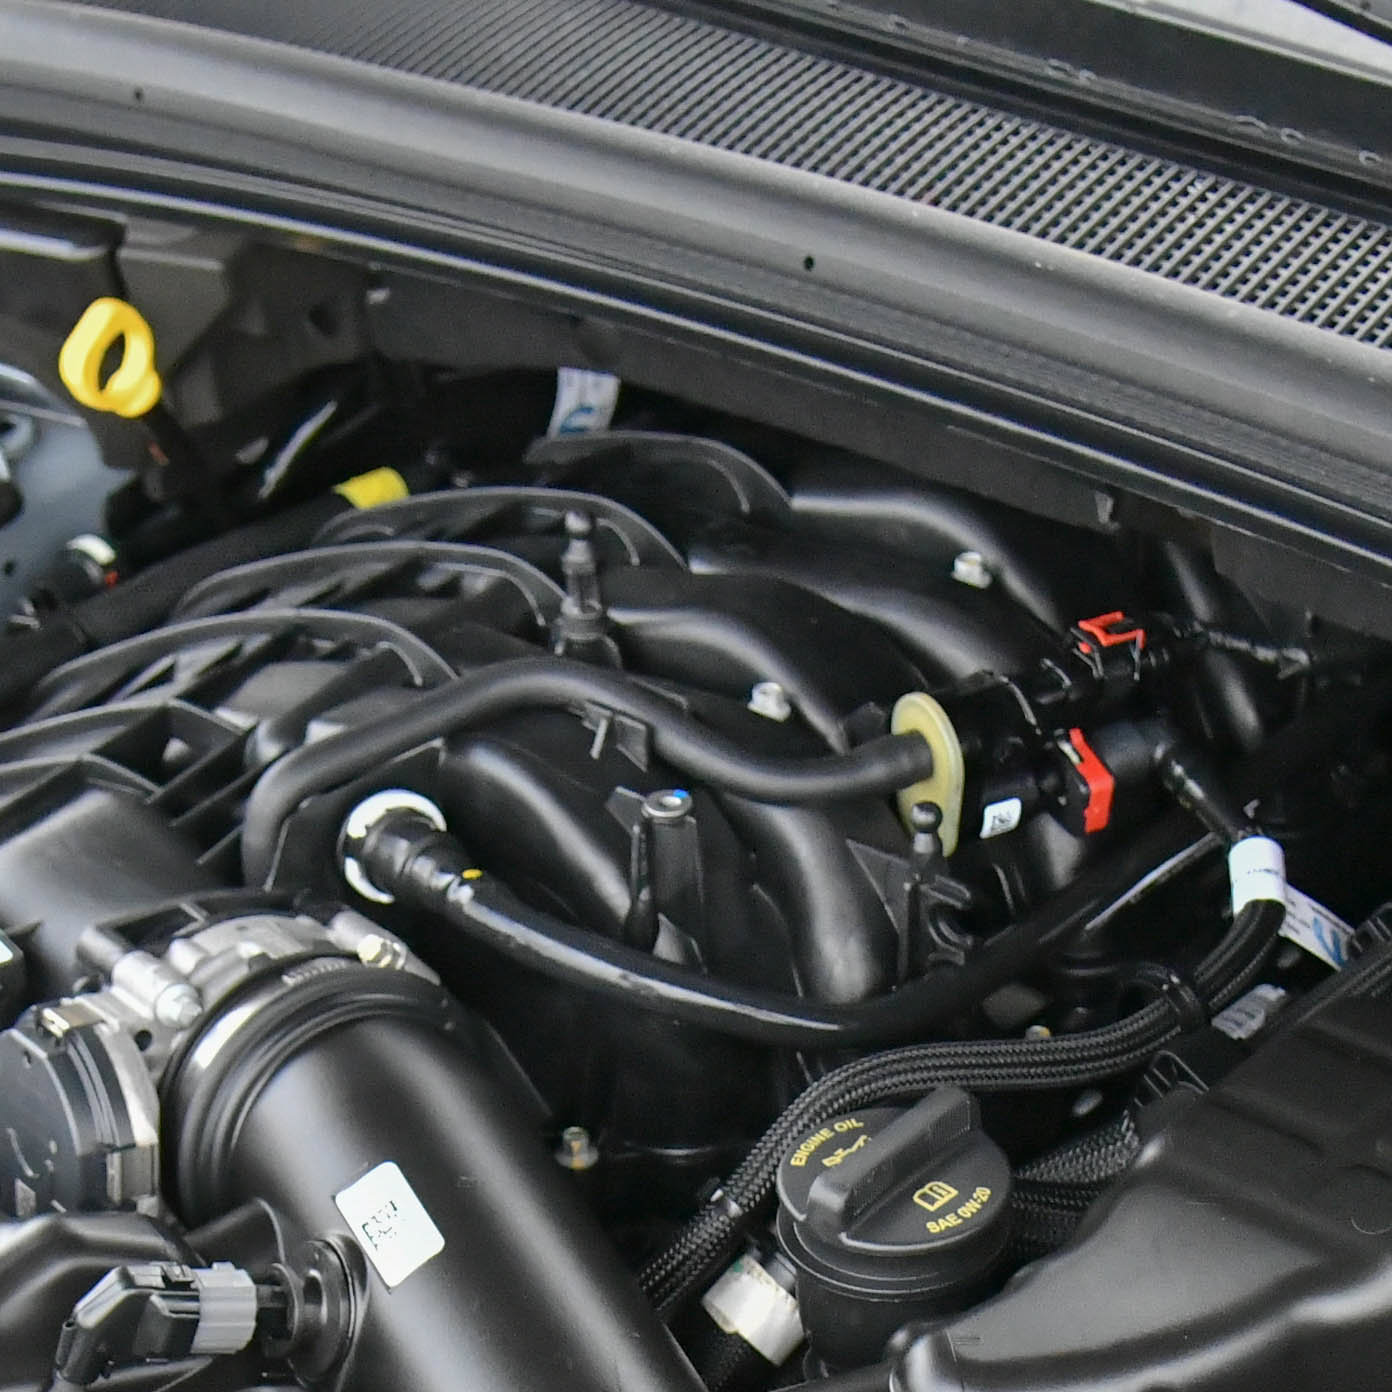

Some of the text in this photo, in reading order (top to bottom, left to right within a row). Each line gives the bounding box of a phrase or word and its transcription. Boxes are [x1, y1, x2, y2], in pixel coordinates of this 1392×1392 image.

[790, 1118, 865, 1167] ENGINE OIL
[925, 1186, 993, 1235] SAE 0W-20
